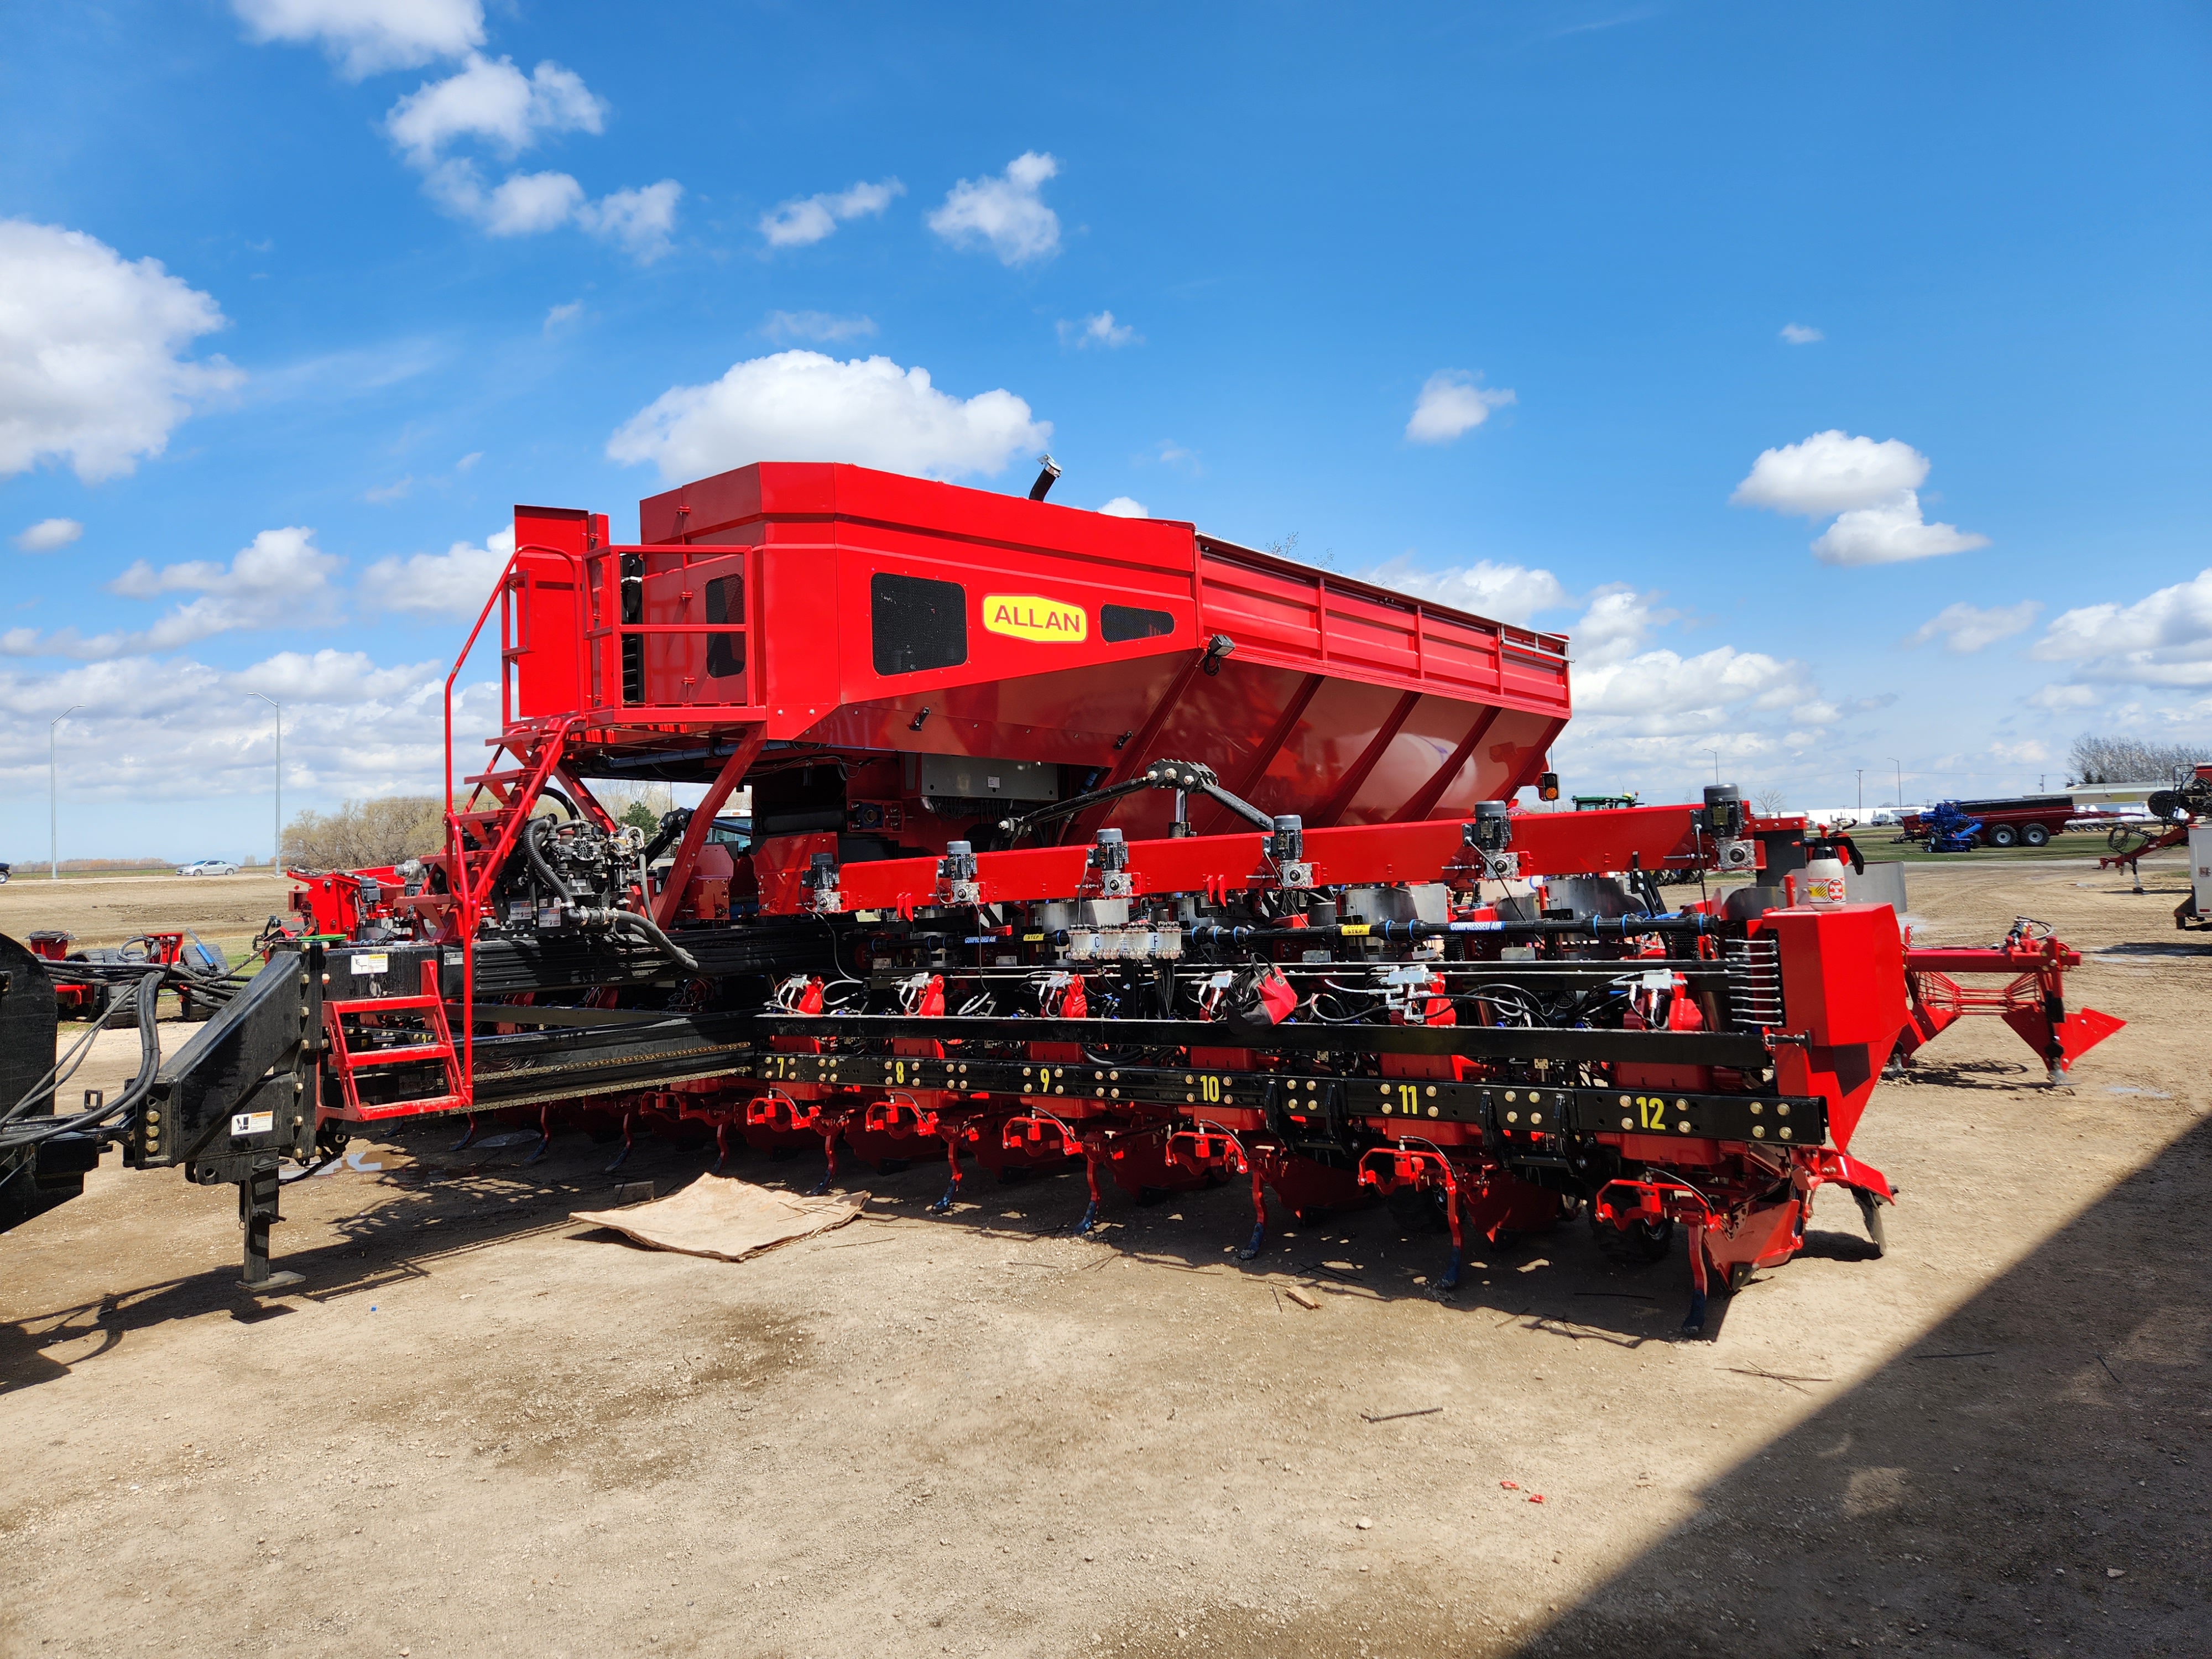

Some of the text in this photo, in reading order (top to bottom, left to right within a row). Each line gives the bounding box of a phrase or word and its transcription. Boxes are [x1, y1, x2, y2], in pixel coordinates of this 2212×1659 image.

[994, 604, 1080, 633] ALLAN
[1451, 921, 1502, 931] COMPRESSED AIR
[1094, 936, 1100, 948] C
[1153, 935, 1158, 947] F
[777, 1057, 784, 1078] 7
[895, 1061, 904, 1084] 8
[1040, 1068, 1050, 1093] 9
[1200, 1075, 1219, 1102] 10
[1399, 1084, 1418, 1115] 11
[1636, 1097, 1666, 1130] 12
